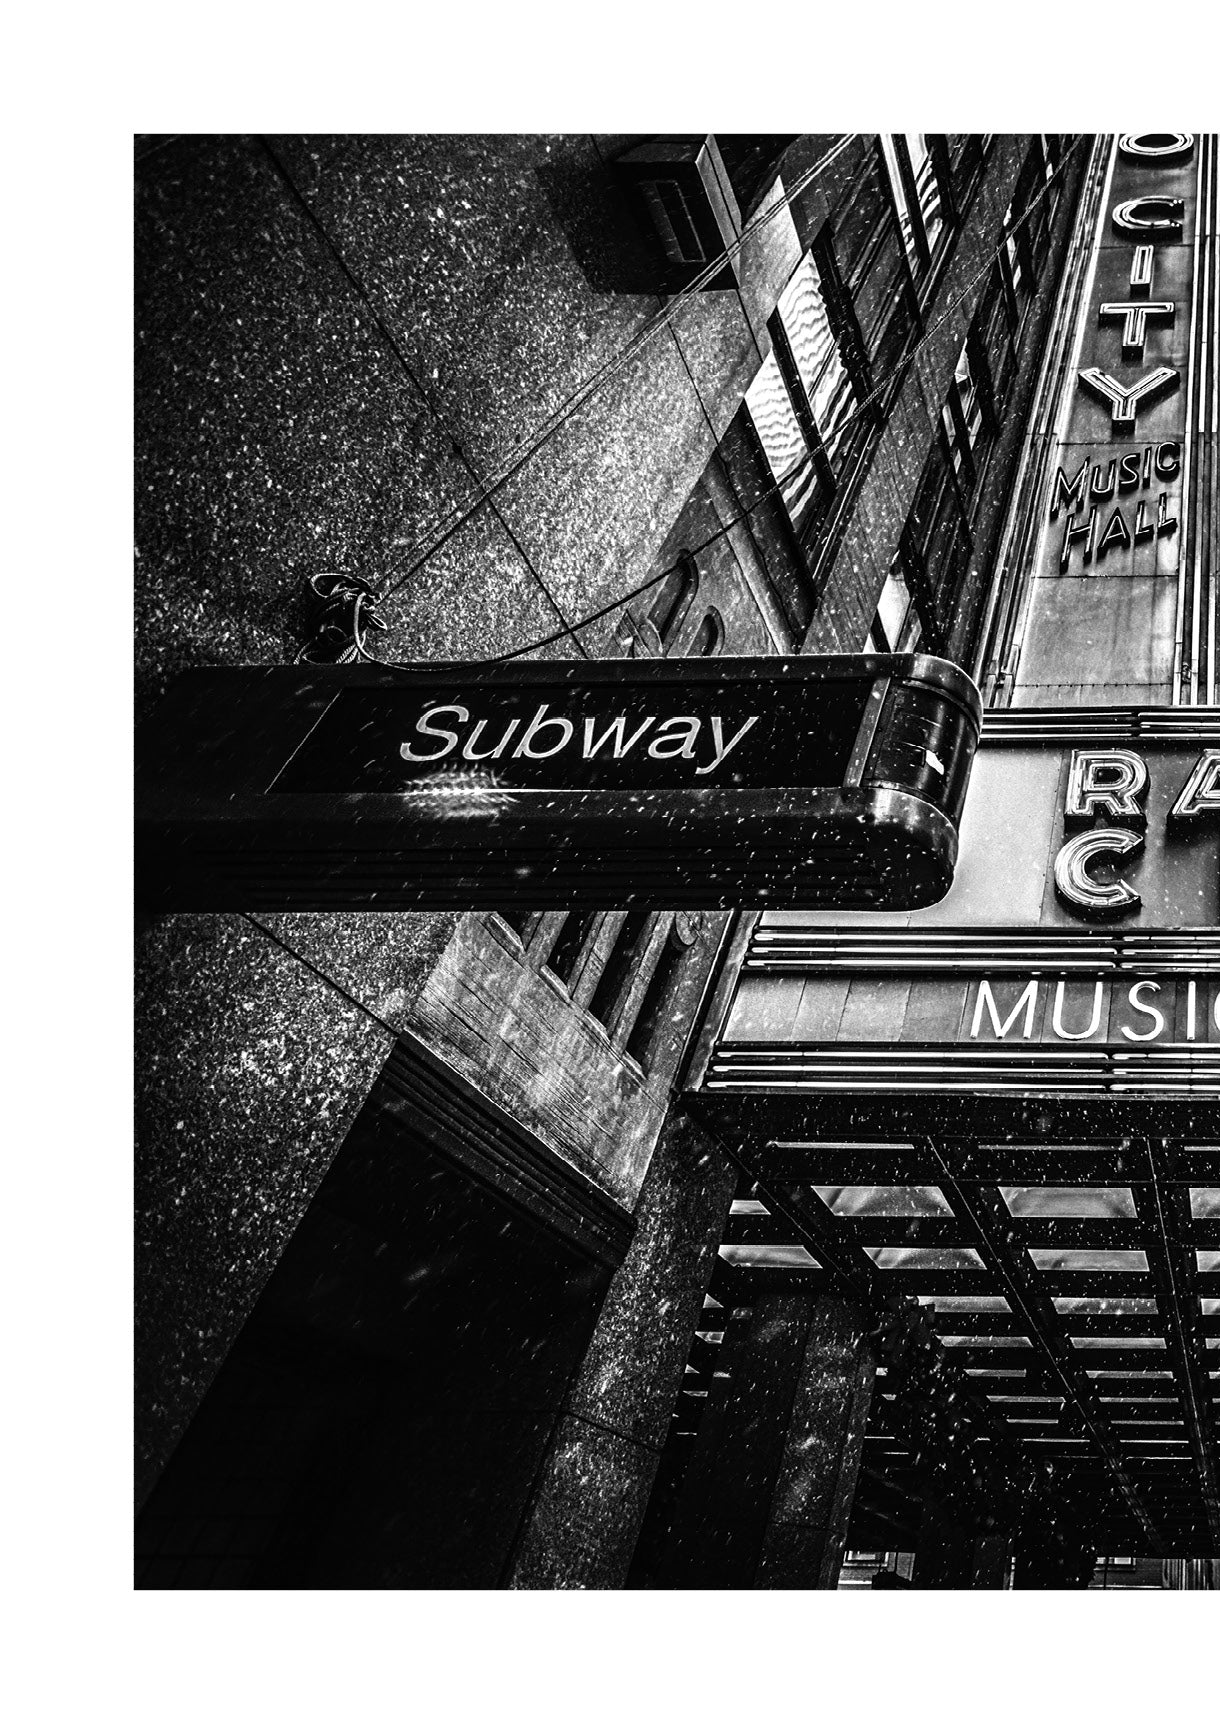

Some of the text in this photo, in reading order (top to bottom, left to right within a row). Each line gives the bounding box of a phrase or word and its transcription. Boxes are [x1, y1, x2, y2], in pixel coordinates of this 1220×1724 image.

[1078, 196, 1185, 432] CITY
[1050, 441, 1180, 517] MUSIC
[1059, 493, 1177, 573] HALL
[399, 704, 758, 773] Subway
